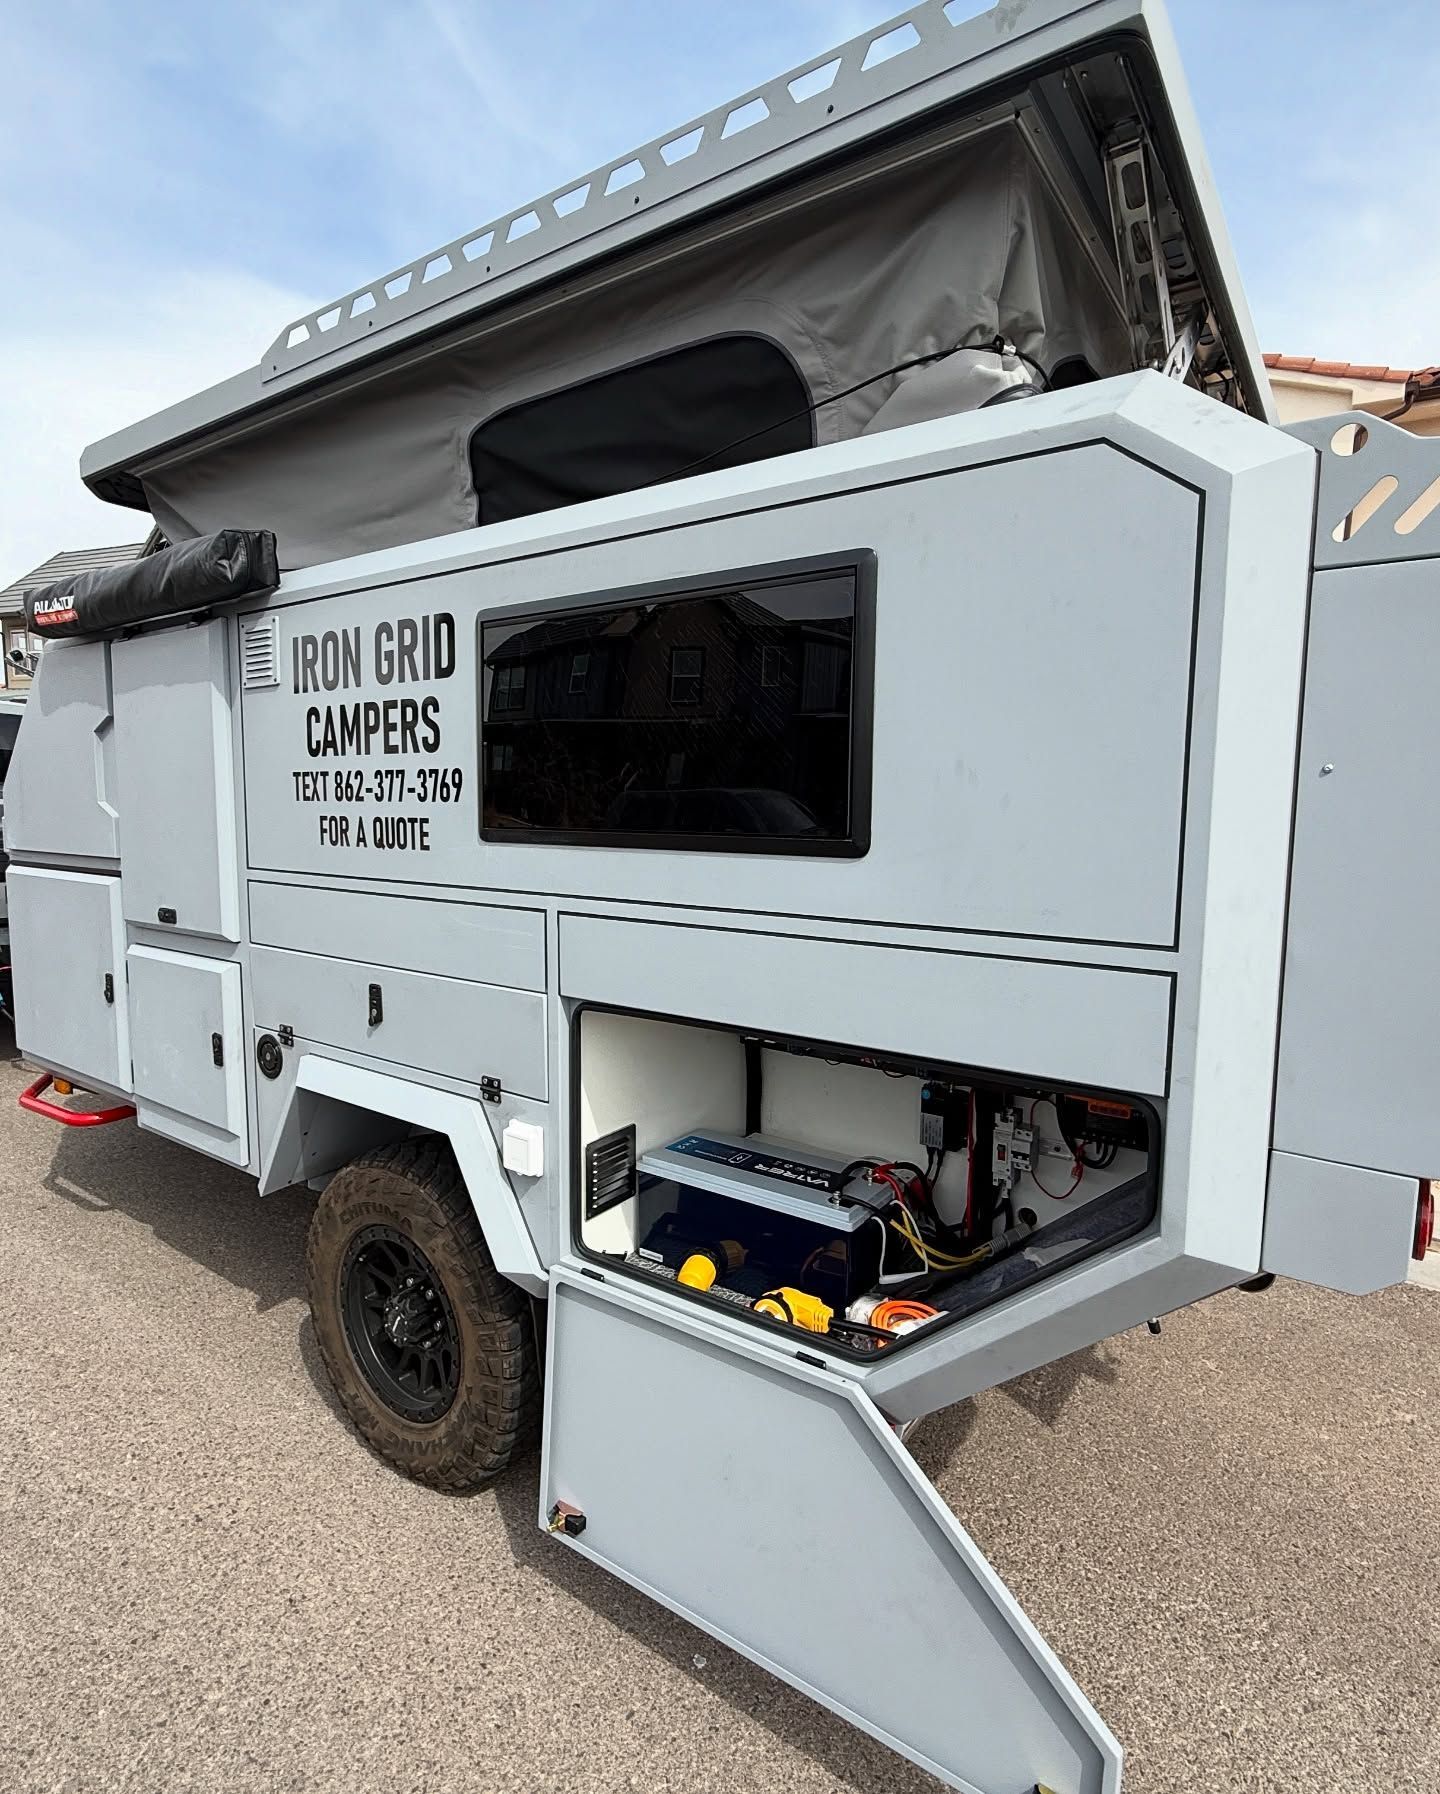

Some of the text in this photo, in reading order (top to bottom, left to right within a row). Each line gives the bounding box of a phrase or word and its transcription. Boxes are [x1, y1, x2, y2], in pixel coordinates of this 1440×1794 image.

[292, 612, 456, 695] IRON GRID
[306, 695, 441, 758] CAMPERS
[292, 767, 463, 803] TEXT 862-377-3769
[319, 815, 430, 851] FOR A QUOTE
[754, 1163, 830, 1188] VATRER
